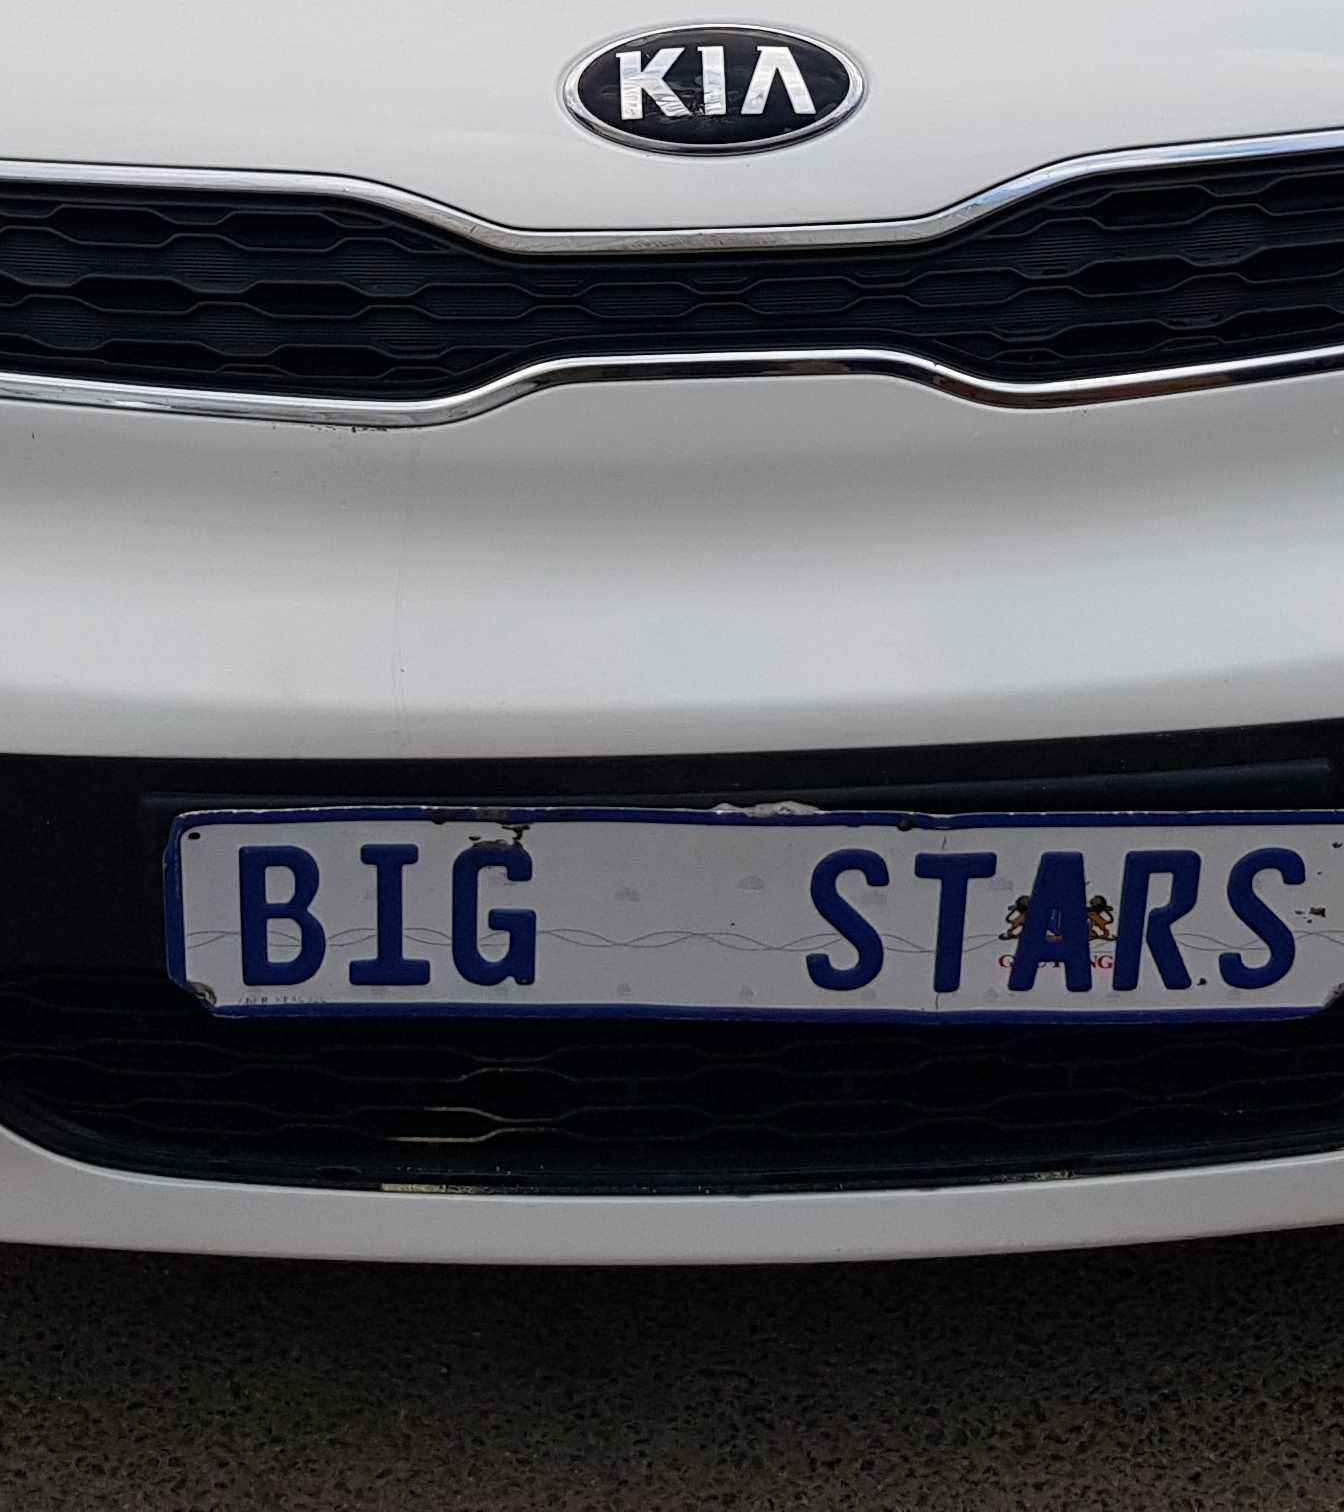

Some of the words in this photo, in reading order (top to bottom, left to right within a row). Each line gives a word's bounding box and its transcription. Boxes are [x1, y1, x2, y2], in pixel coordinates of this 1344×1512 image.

[615, 45, 817, 120] KIA
[239, 842, 537, 986] BIG
[805, 847, 1306, 992] STARS
